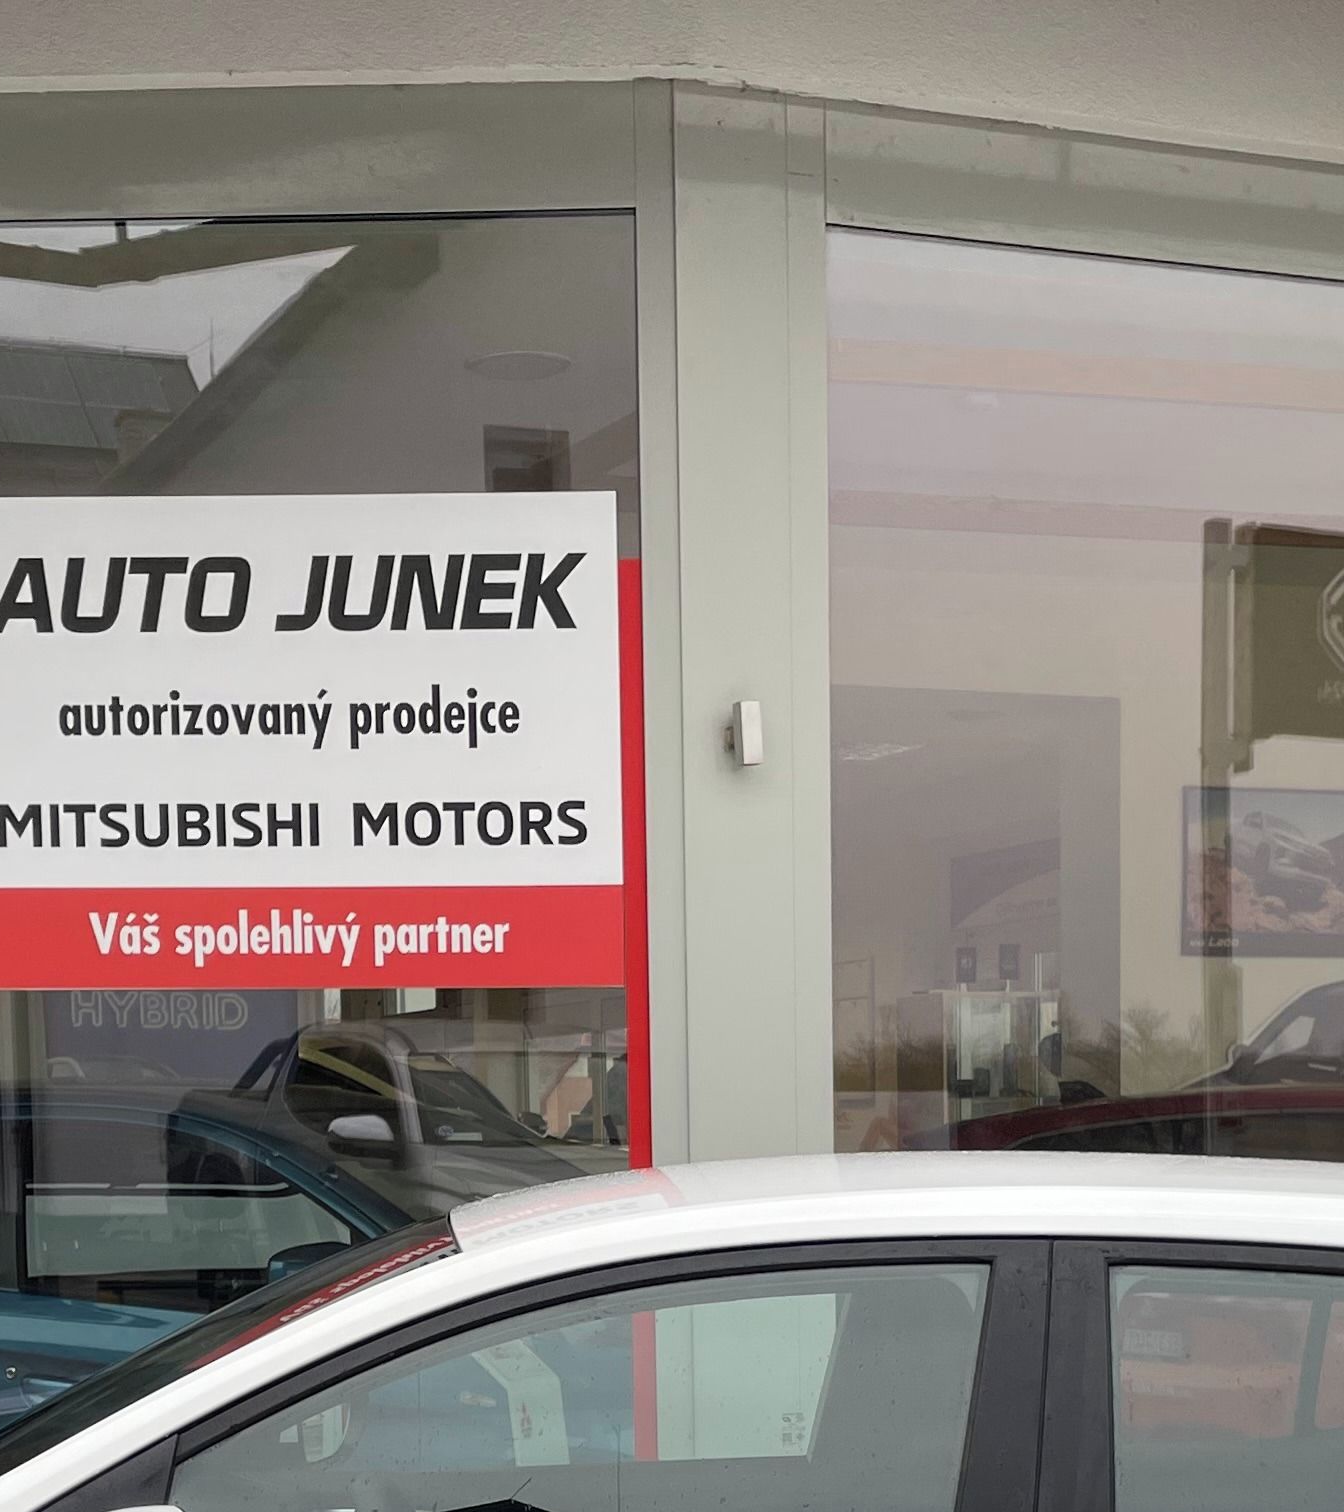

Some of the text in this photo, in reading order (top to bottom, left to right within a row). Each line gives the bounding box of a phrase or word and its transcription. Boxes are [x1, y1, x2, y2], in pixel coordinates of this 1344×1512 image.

[274, 552, 587, 632] JUNEK
[59, 684, 520, 750] autorizovaný prodejce
[352, 800, 588, 847] MOTORS
[88, 909, 510, 968] Váš spolehlivý partner
[71, 989, 248, 1031] HYBRID
